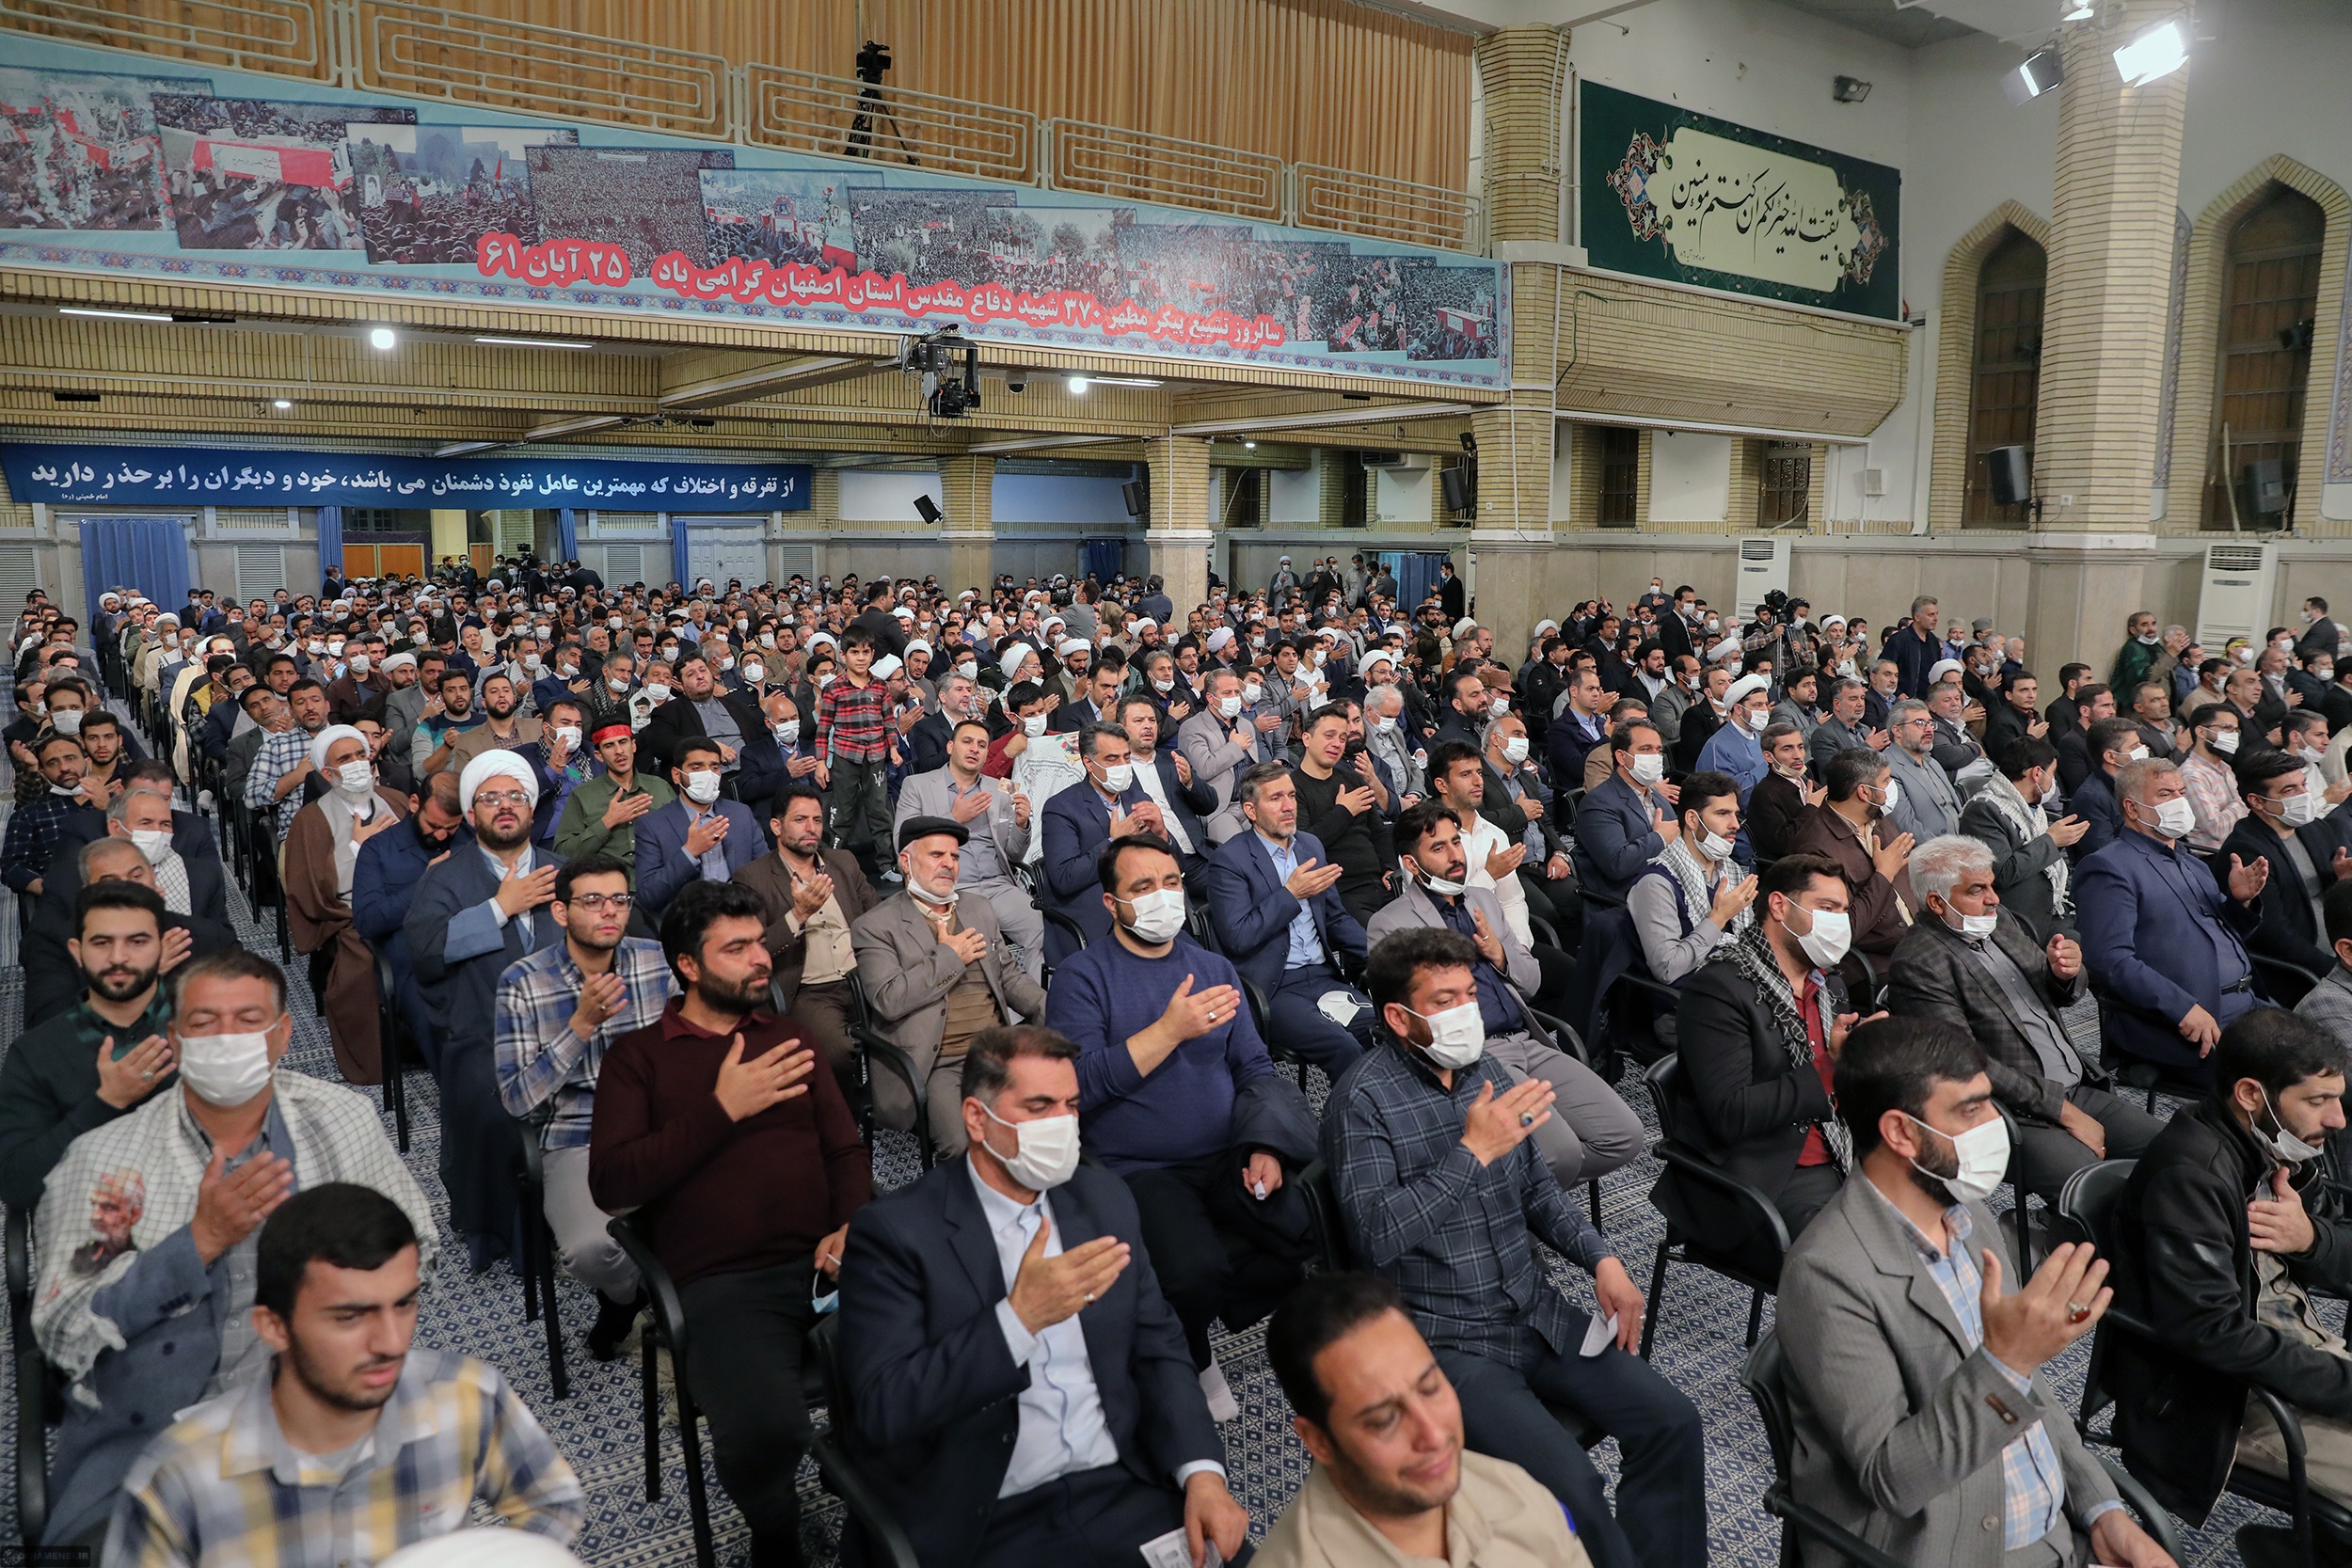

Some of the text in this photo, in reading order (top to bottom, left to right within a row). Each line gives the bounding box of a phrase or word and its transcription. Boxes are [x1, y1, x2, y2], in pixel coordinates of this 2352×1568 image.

[485, 240, 624, 279] ۲۵ آبان ۶۱
[659, 259, 1280, 344] سالروز تشییع پیکر مطهر ۳۷۰ شهید دفاع مقدس استان اصفهان گرامی باد
[31, 461, 95, 488] دارید
[178, 465, 200, 490] را
[204, 466, 276, 490] دیگران
[282, 474, 293, 491] و
[296, 468, 338, 492] خود
[431, 472, 495, 496] دشمنان
[499, 473, 534, 497] نفوذ
[538, 474, 579, 495] عامل
[650, 477, 670, 493] که
[673, 476, 725, 495] اختلاف
[397, 478, 426, 495] می
[582, 477, 646, 498] مهمترین
[729, 485, 739, 499] و
[741, 477, 777, 499] تفرقه
[781, 477, 794, 498] از
